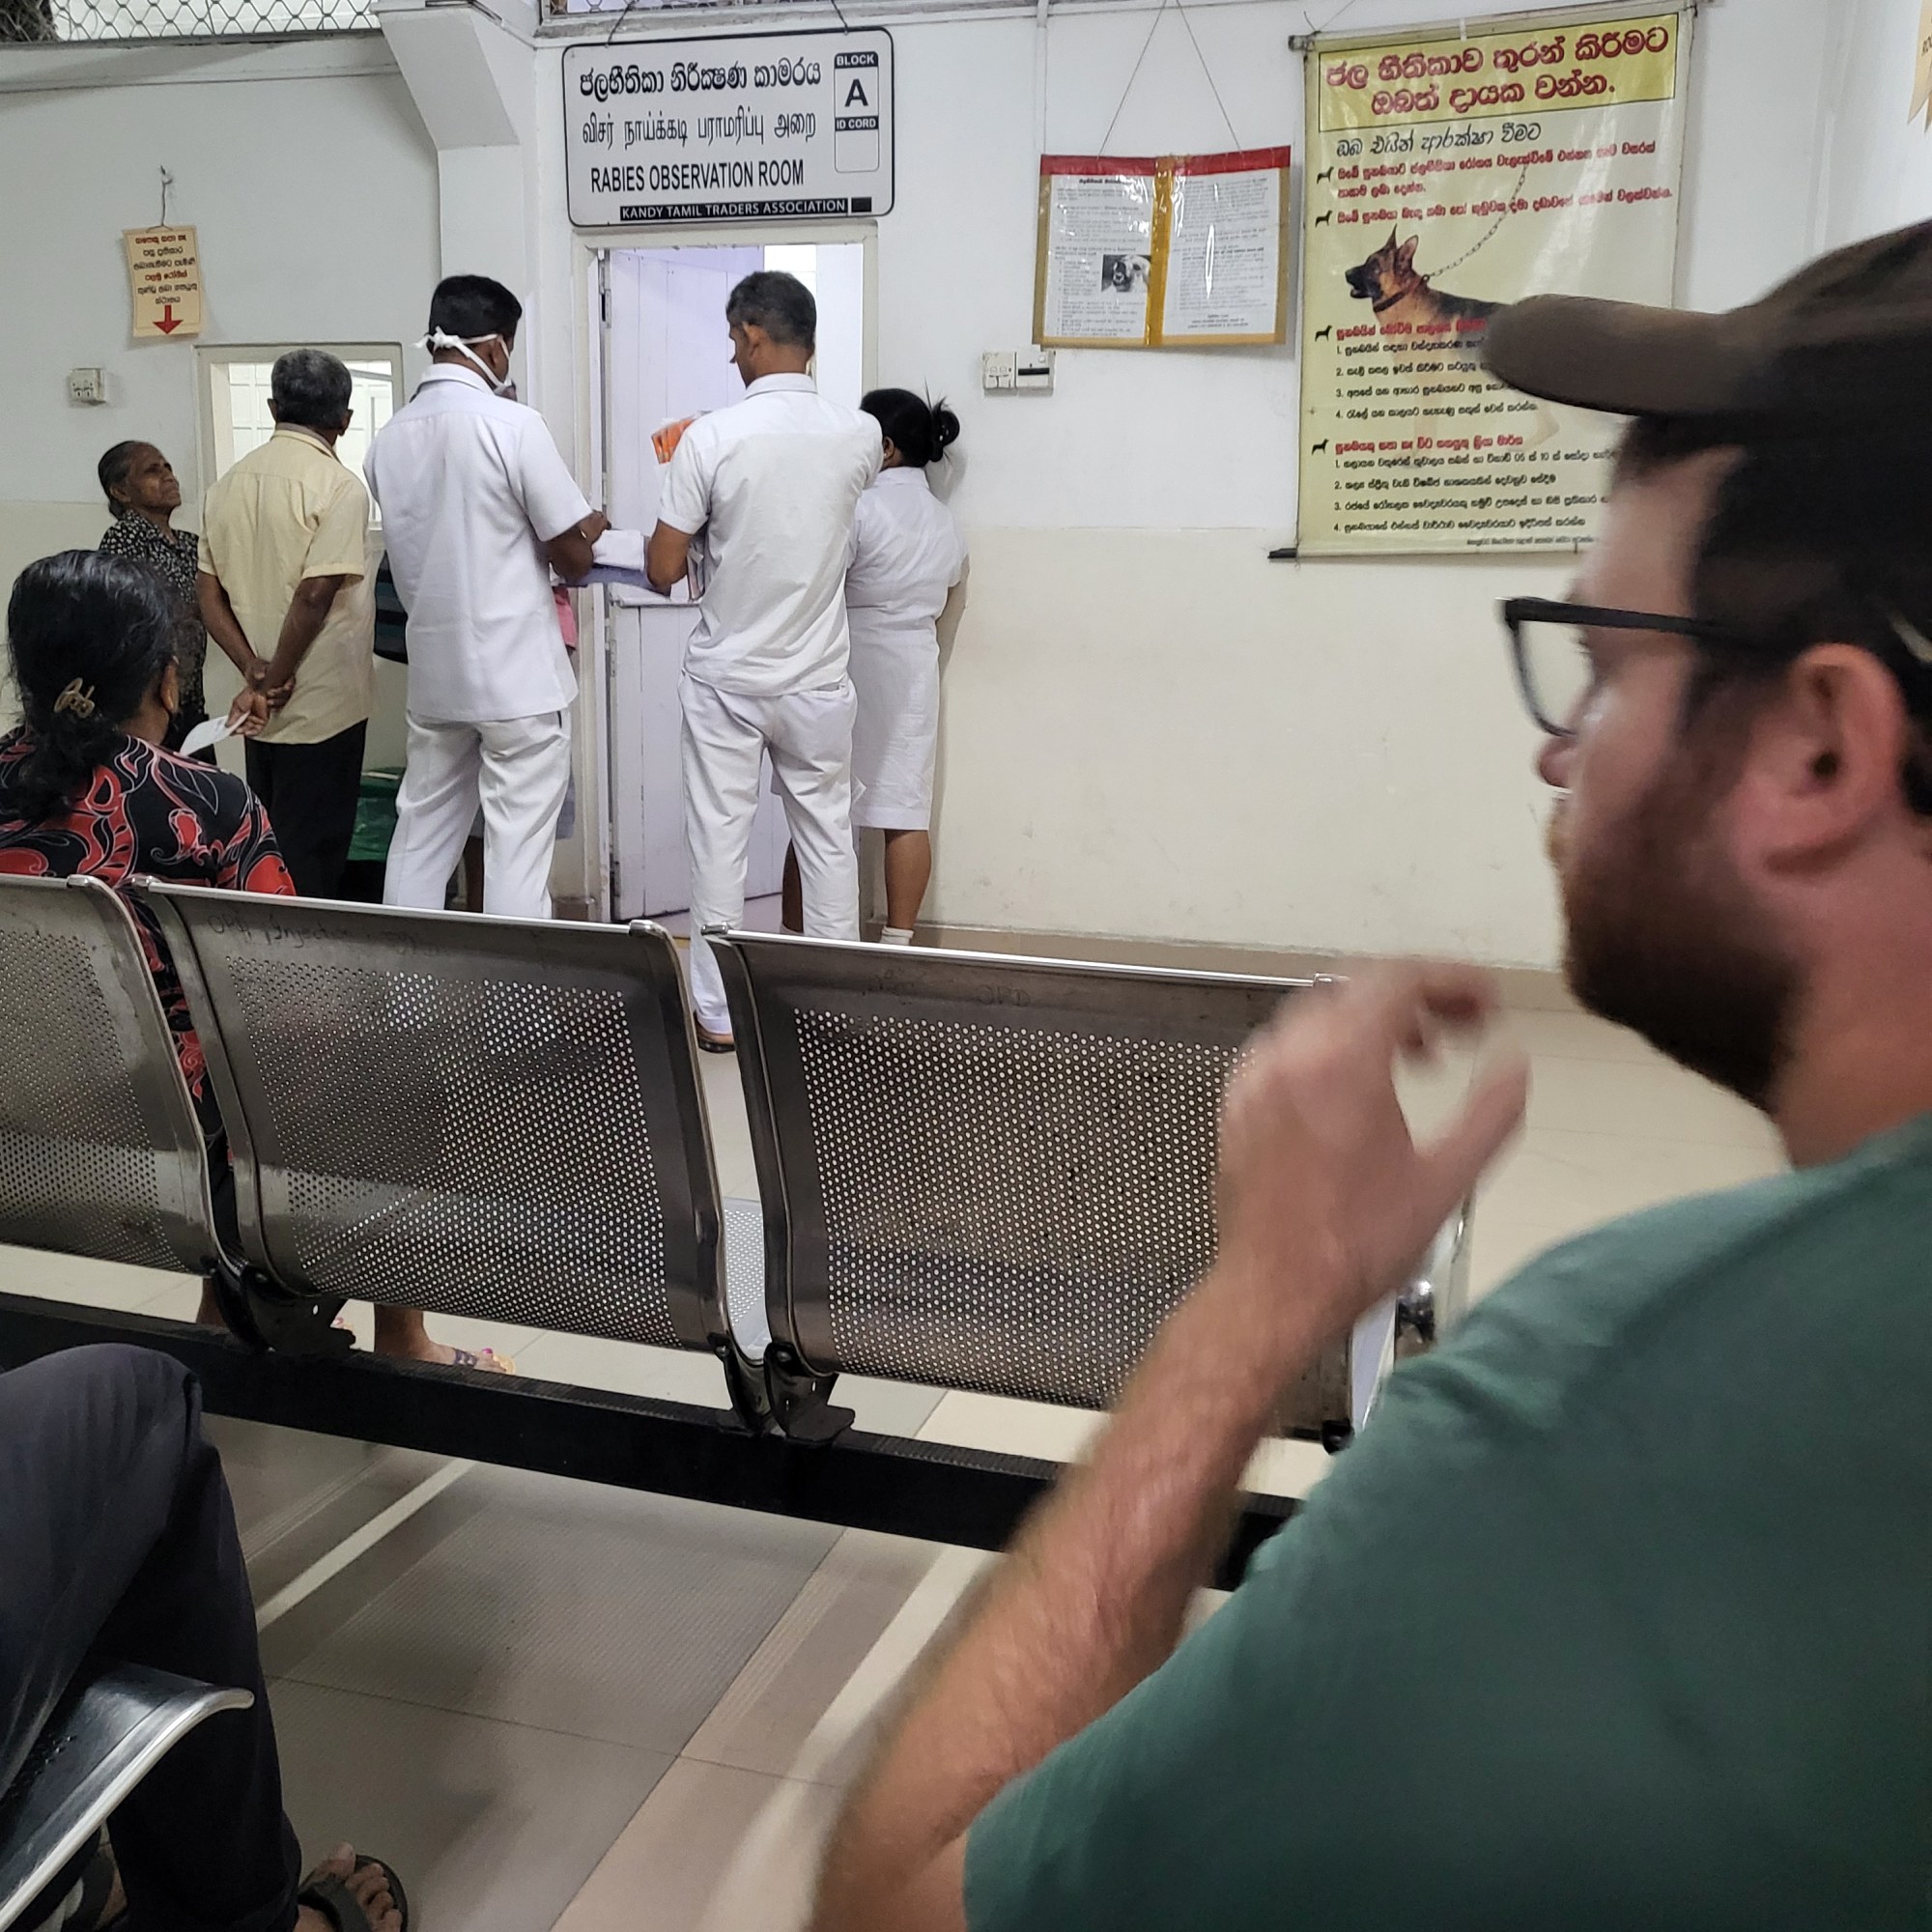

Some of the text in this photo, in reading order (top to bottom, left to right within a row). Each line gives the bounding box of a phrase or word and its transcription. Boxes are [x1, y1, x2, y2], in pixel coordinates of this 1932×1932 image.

[753, 56, 821, 88] කාමරය
[837, 54, 875, 66] BLOCK
[1326, 61, 1368, 89] ජල
[1493, 36, 1565, 72] තුරන්
[1575, 27, 1668, 61] කිරීමට
[844, 79, 868, 107] A
[1372, 69, 1615, 115] ඔබත් දායක වන්න.
[582, 104, 815, 151] விசர் நாய்க்கடி பராமரிப்பு அறை
[836, 118, 876, 129] ID CORD
[1337, 138, 1362, 156] ඔබ
[1370, 129, 1414, 154] එයින්
[1501, 123, 1541, 142] වීමට
[591, 159, 804, 192] RABIES OBSERVATION ROOM
[622, 200, 845, 219] KANDY TAMIL TRADERS ASSOCIATION
